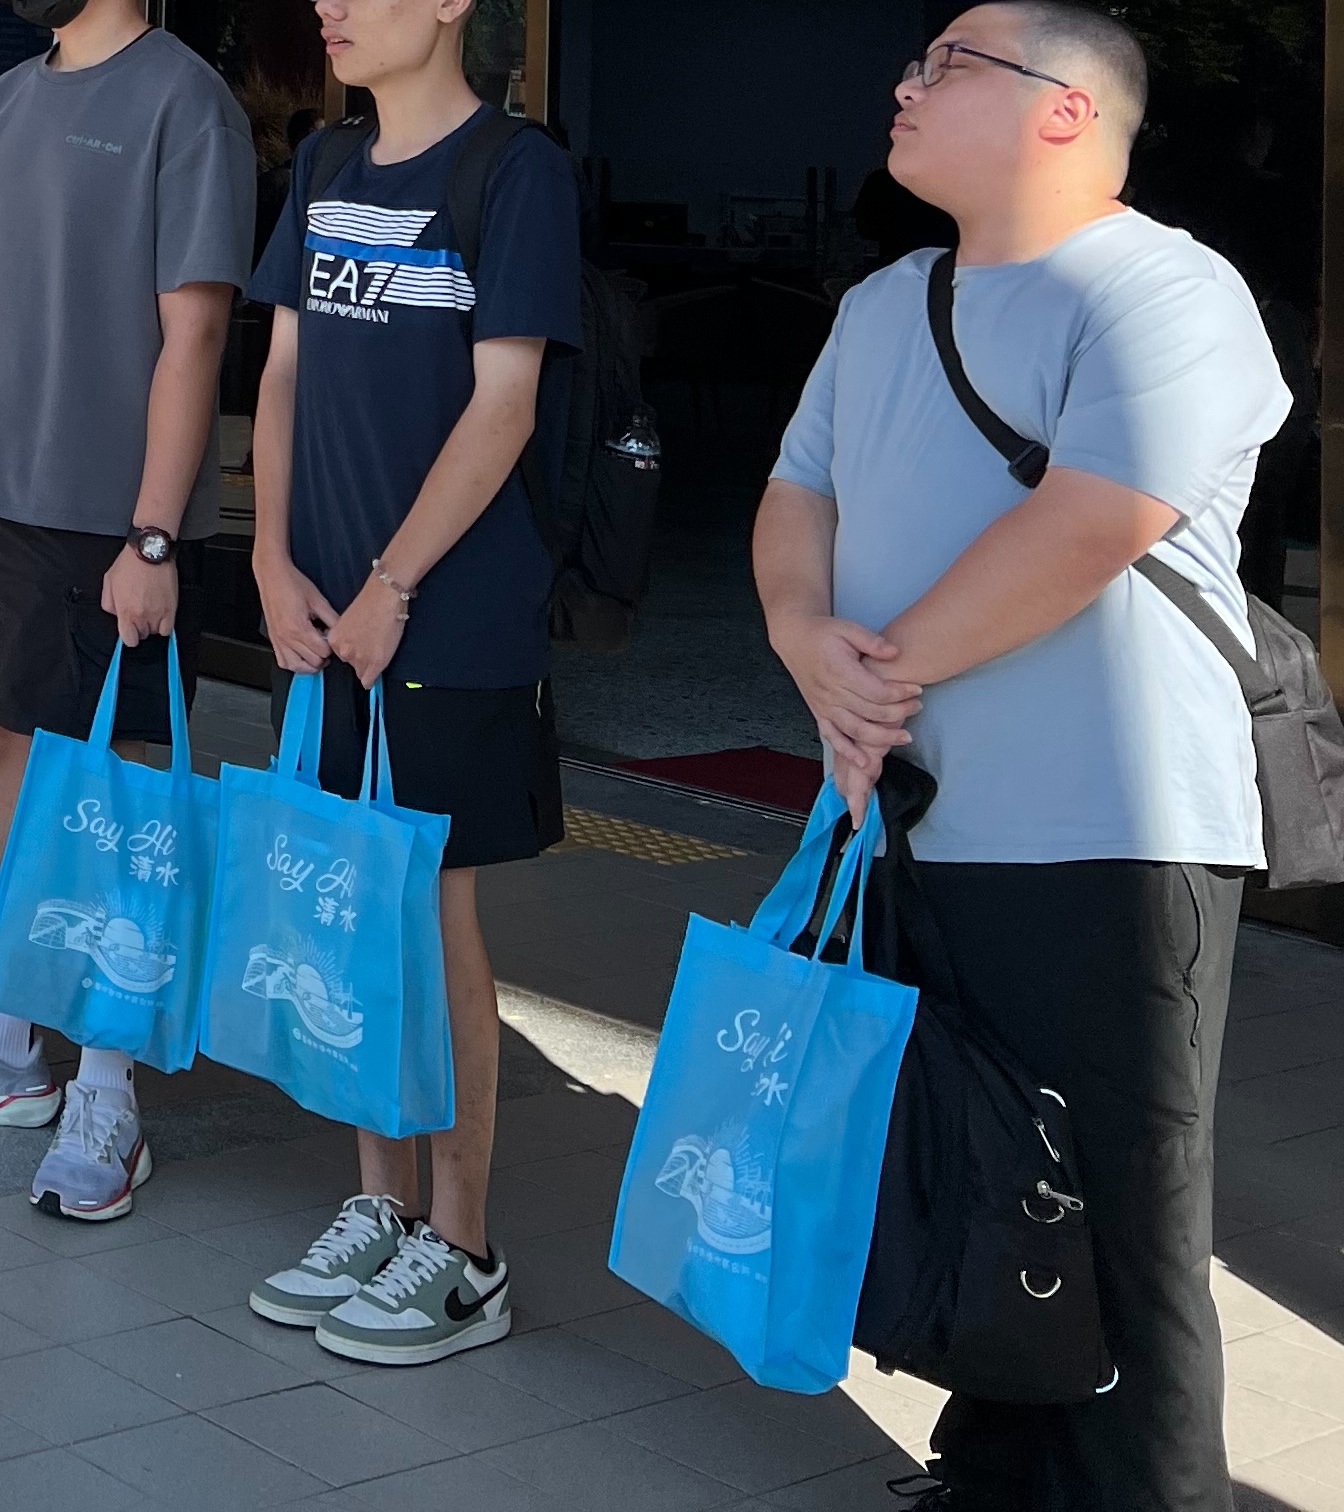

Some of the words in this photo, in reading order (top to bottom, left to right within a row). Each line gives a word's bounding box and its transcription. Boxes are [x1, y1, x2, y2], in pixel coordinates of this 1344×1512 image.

[309, 251, 397, 307] EA7
[348, 306, 390, 324] ARMANI
[63, 798, 125, 853] Say
[126, 819, 177, 857] Hi
[128, 855, 180, 888] 清水
[266, 833, 315, 893] Say
[315, 857, 357, 900] Hi
[313, 896, 358, 933] 清水
